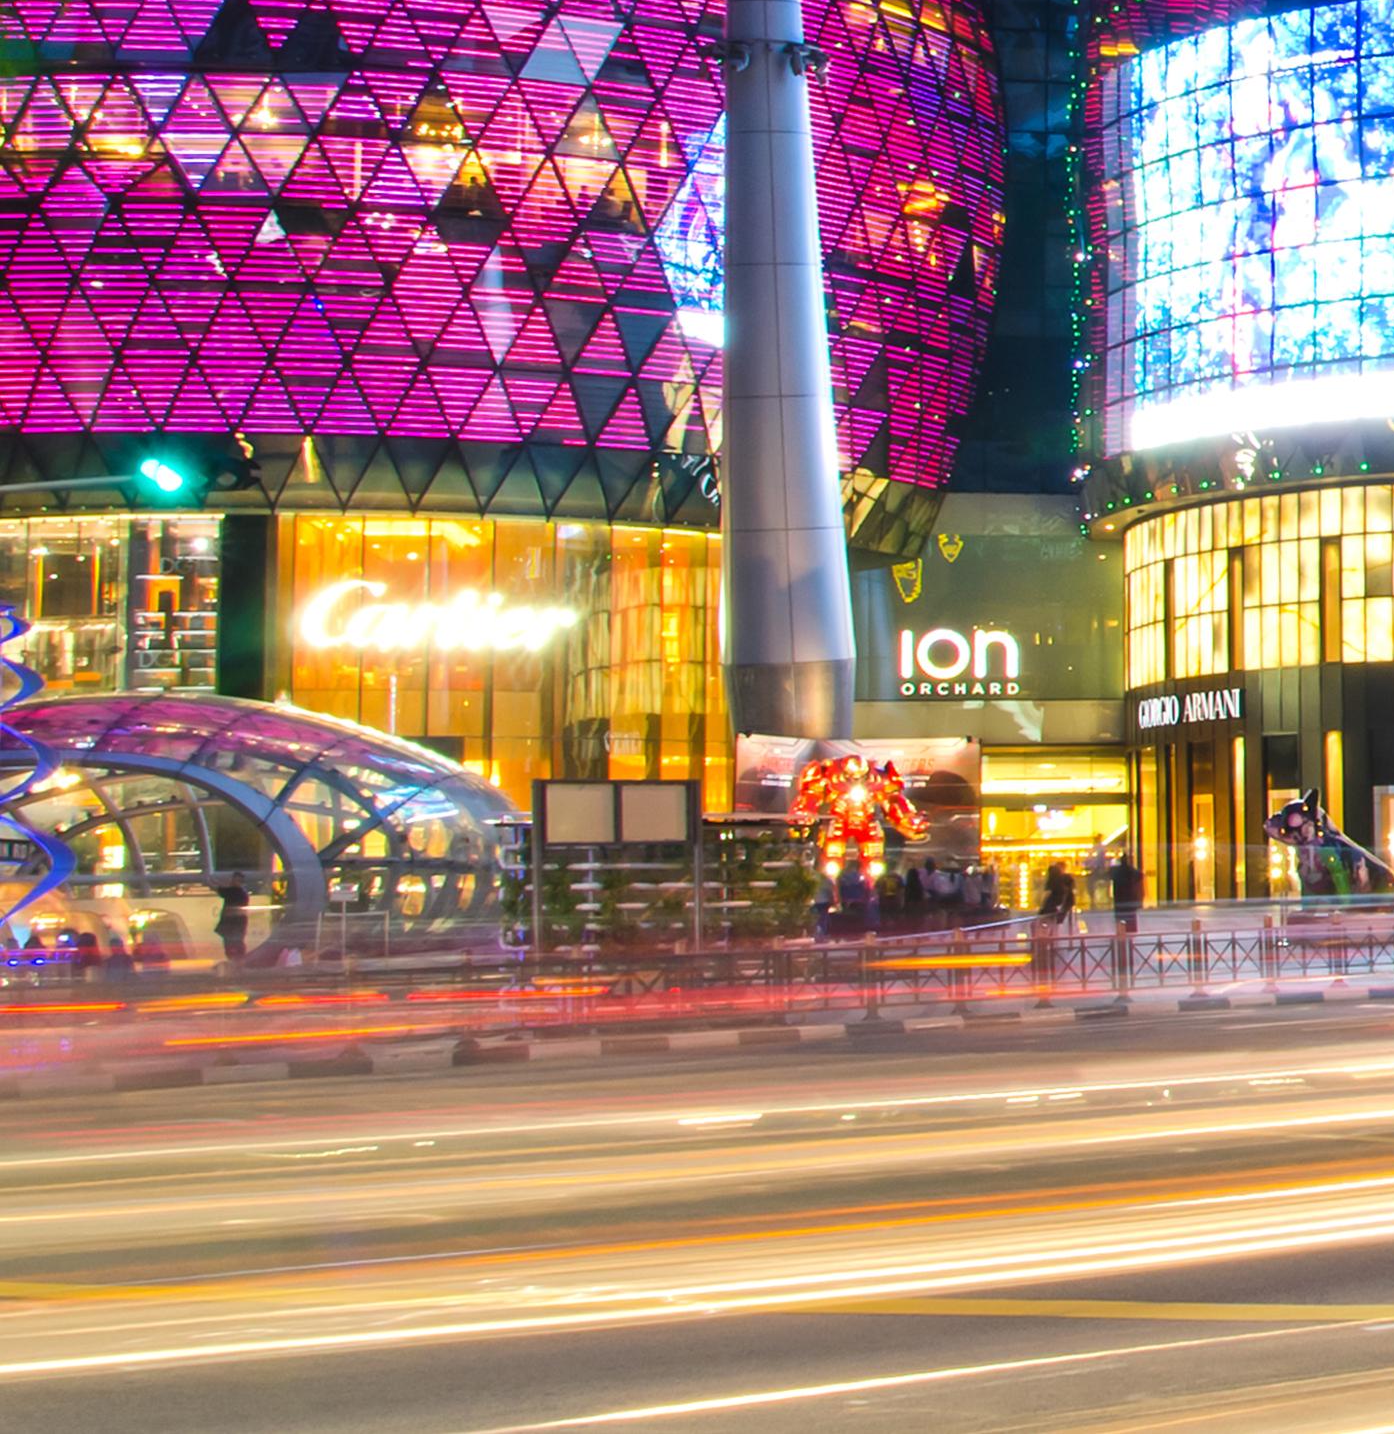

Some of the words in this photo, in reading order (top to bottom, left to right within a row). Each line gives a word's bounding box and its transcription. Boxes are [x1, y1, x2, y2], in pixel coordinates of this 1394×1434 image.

[299, 578, 580, 652] Cartier
[900, 681, 1020, 696] ORCHARD
[1138, 695, 1180, 729] GIORGIO
[1182, 688, 1241, 723] ARMANI
